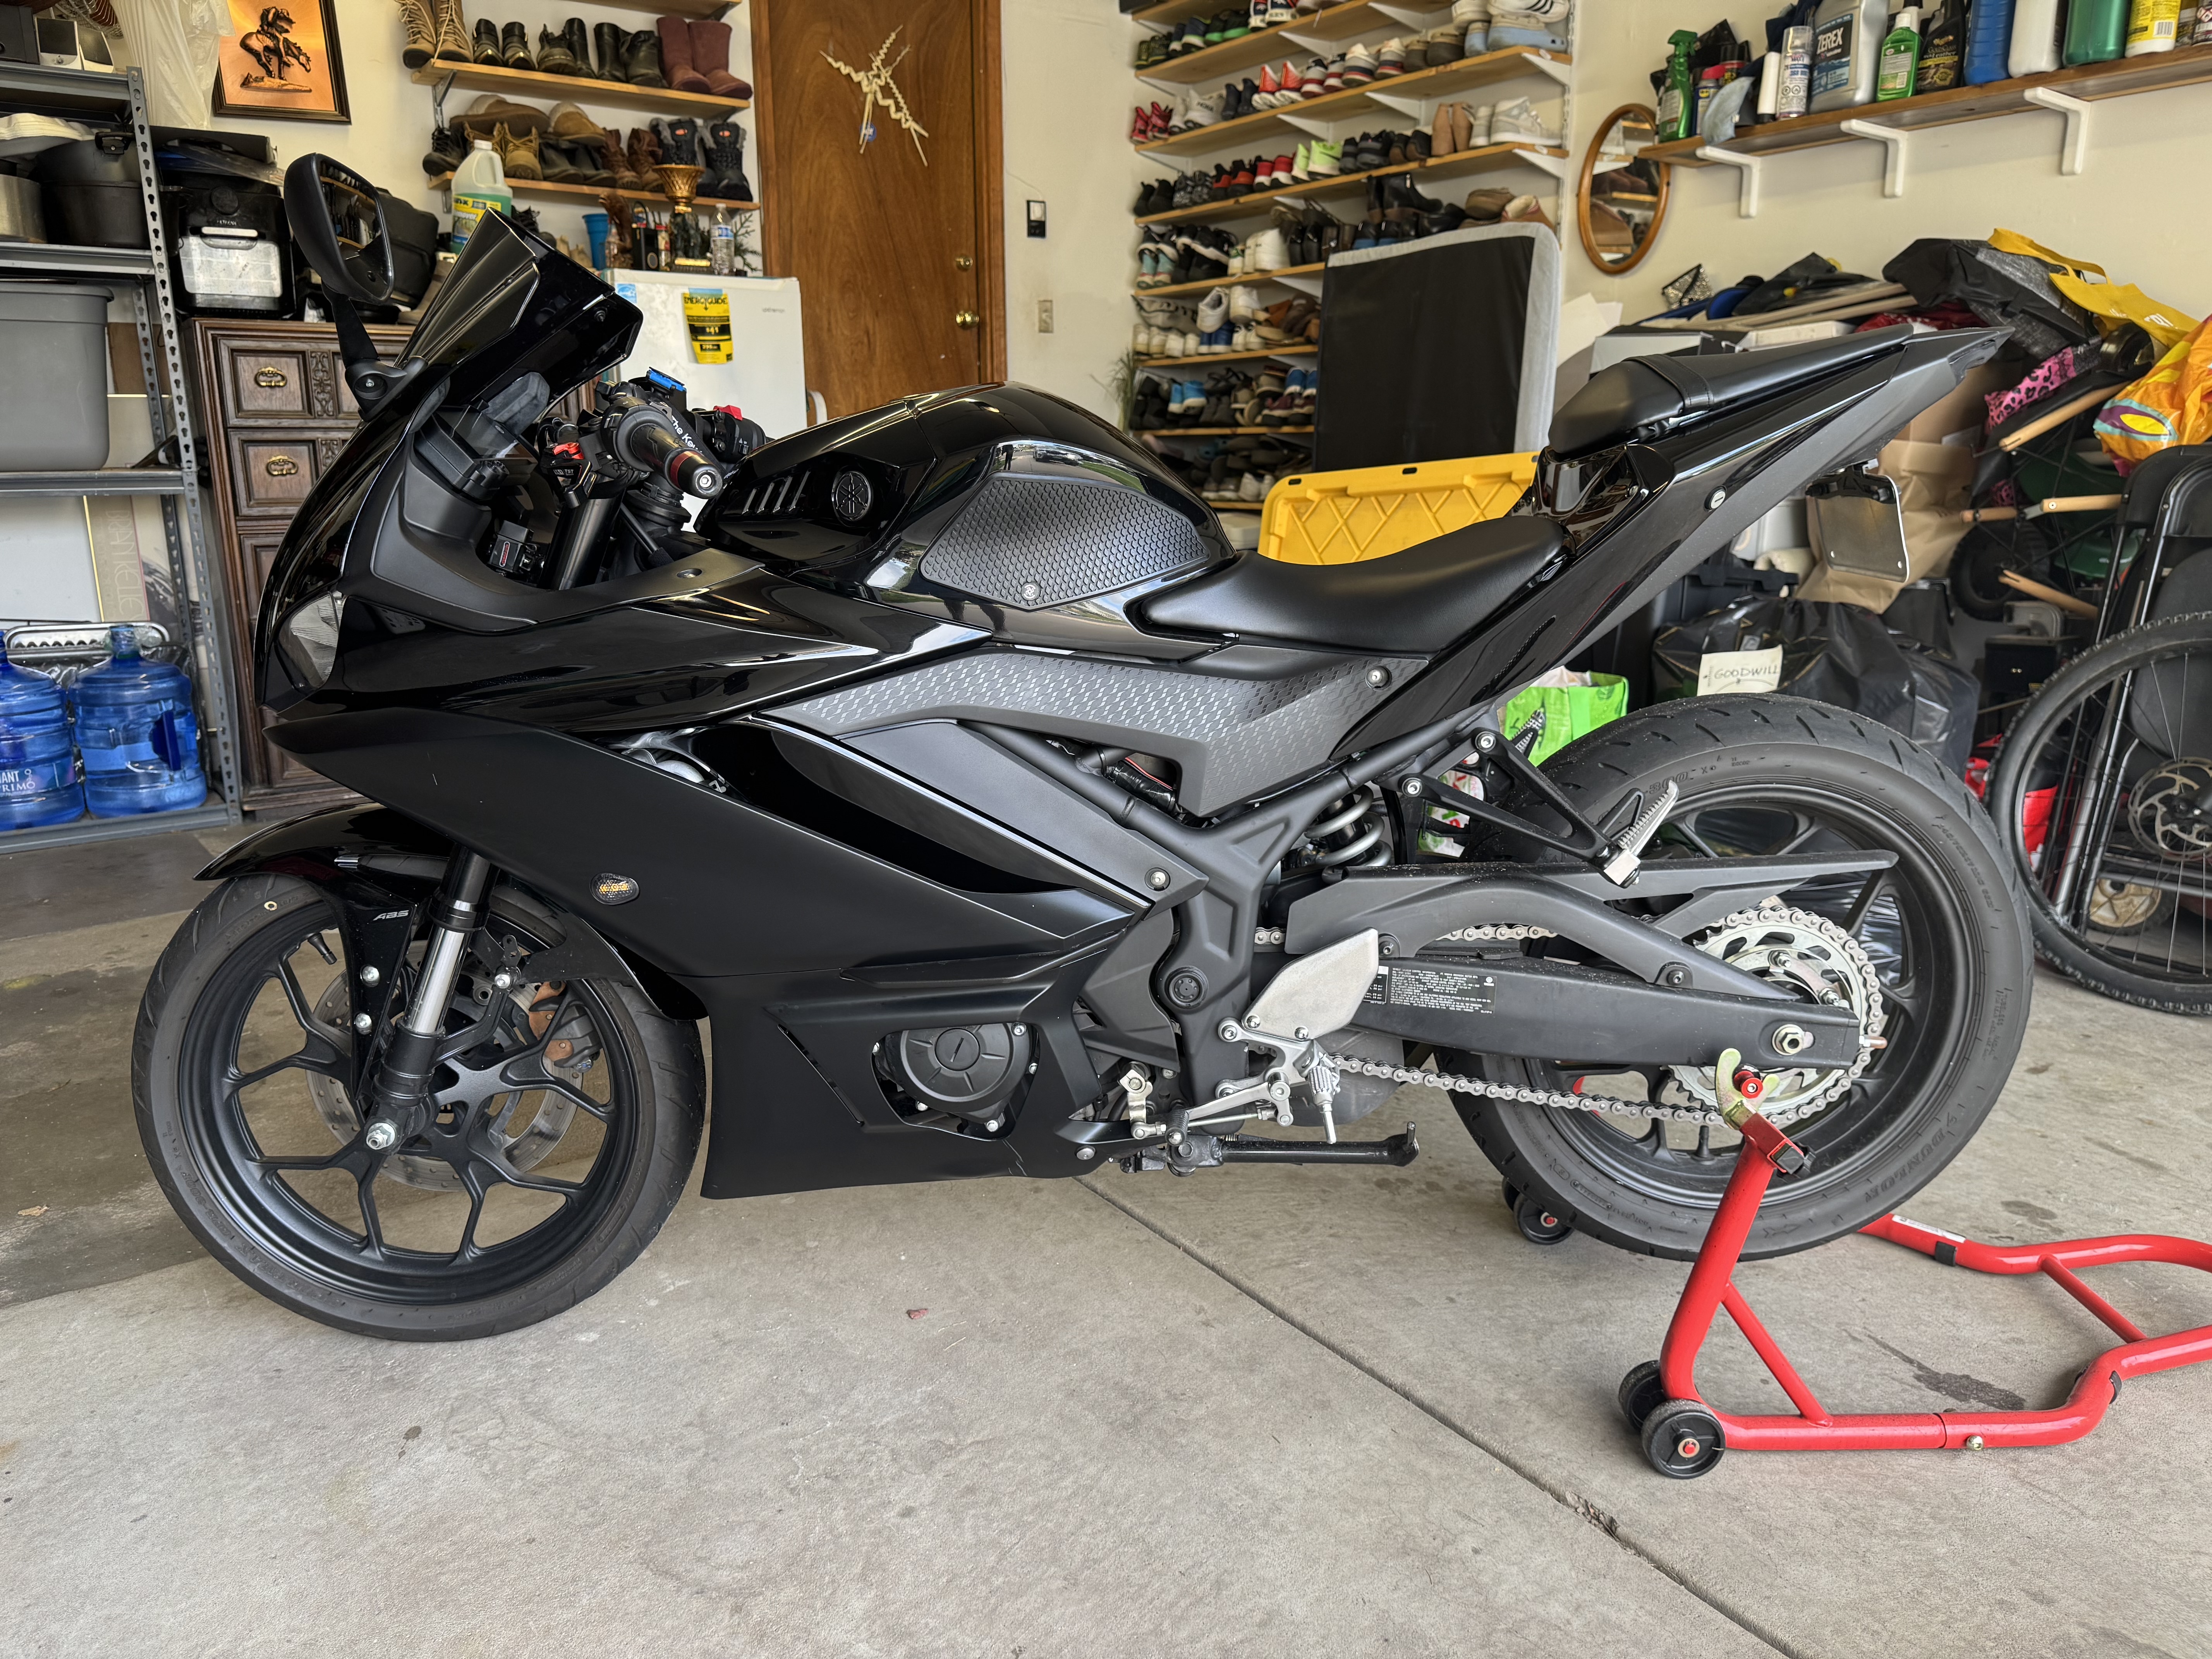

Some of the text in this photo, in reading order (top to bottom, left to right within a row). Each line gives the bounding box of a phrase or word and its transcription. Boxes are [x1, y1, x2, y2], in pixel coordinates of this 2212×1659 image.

[1817, 27, 1844, 55] ZEREX
[672, 415, 684, 435] The
[105, 509, 136, 556] BRIAN
[1714, 665, 1778, 679] GOODWILL
[0, 770, 19, 783] ANT
[0, 781, 35, 792] RIMO
[373, 910, 409, 921] ABS
[1864, 1127, 1946, 1202] DUNLOP
